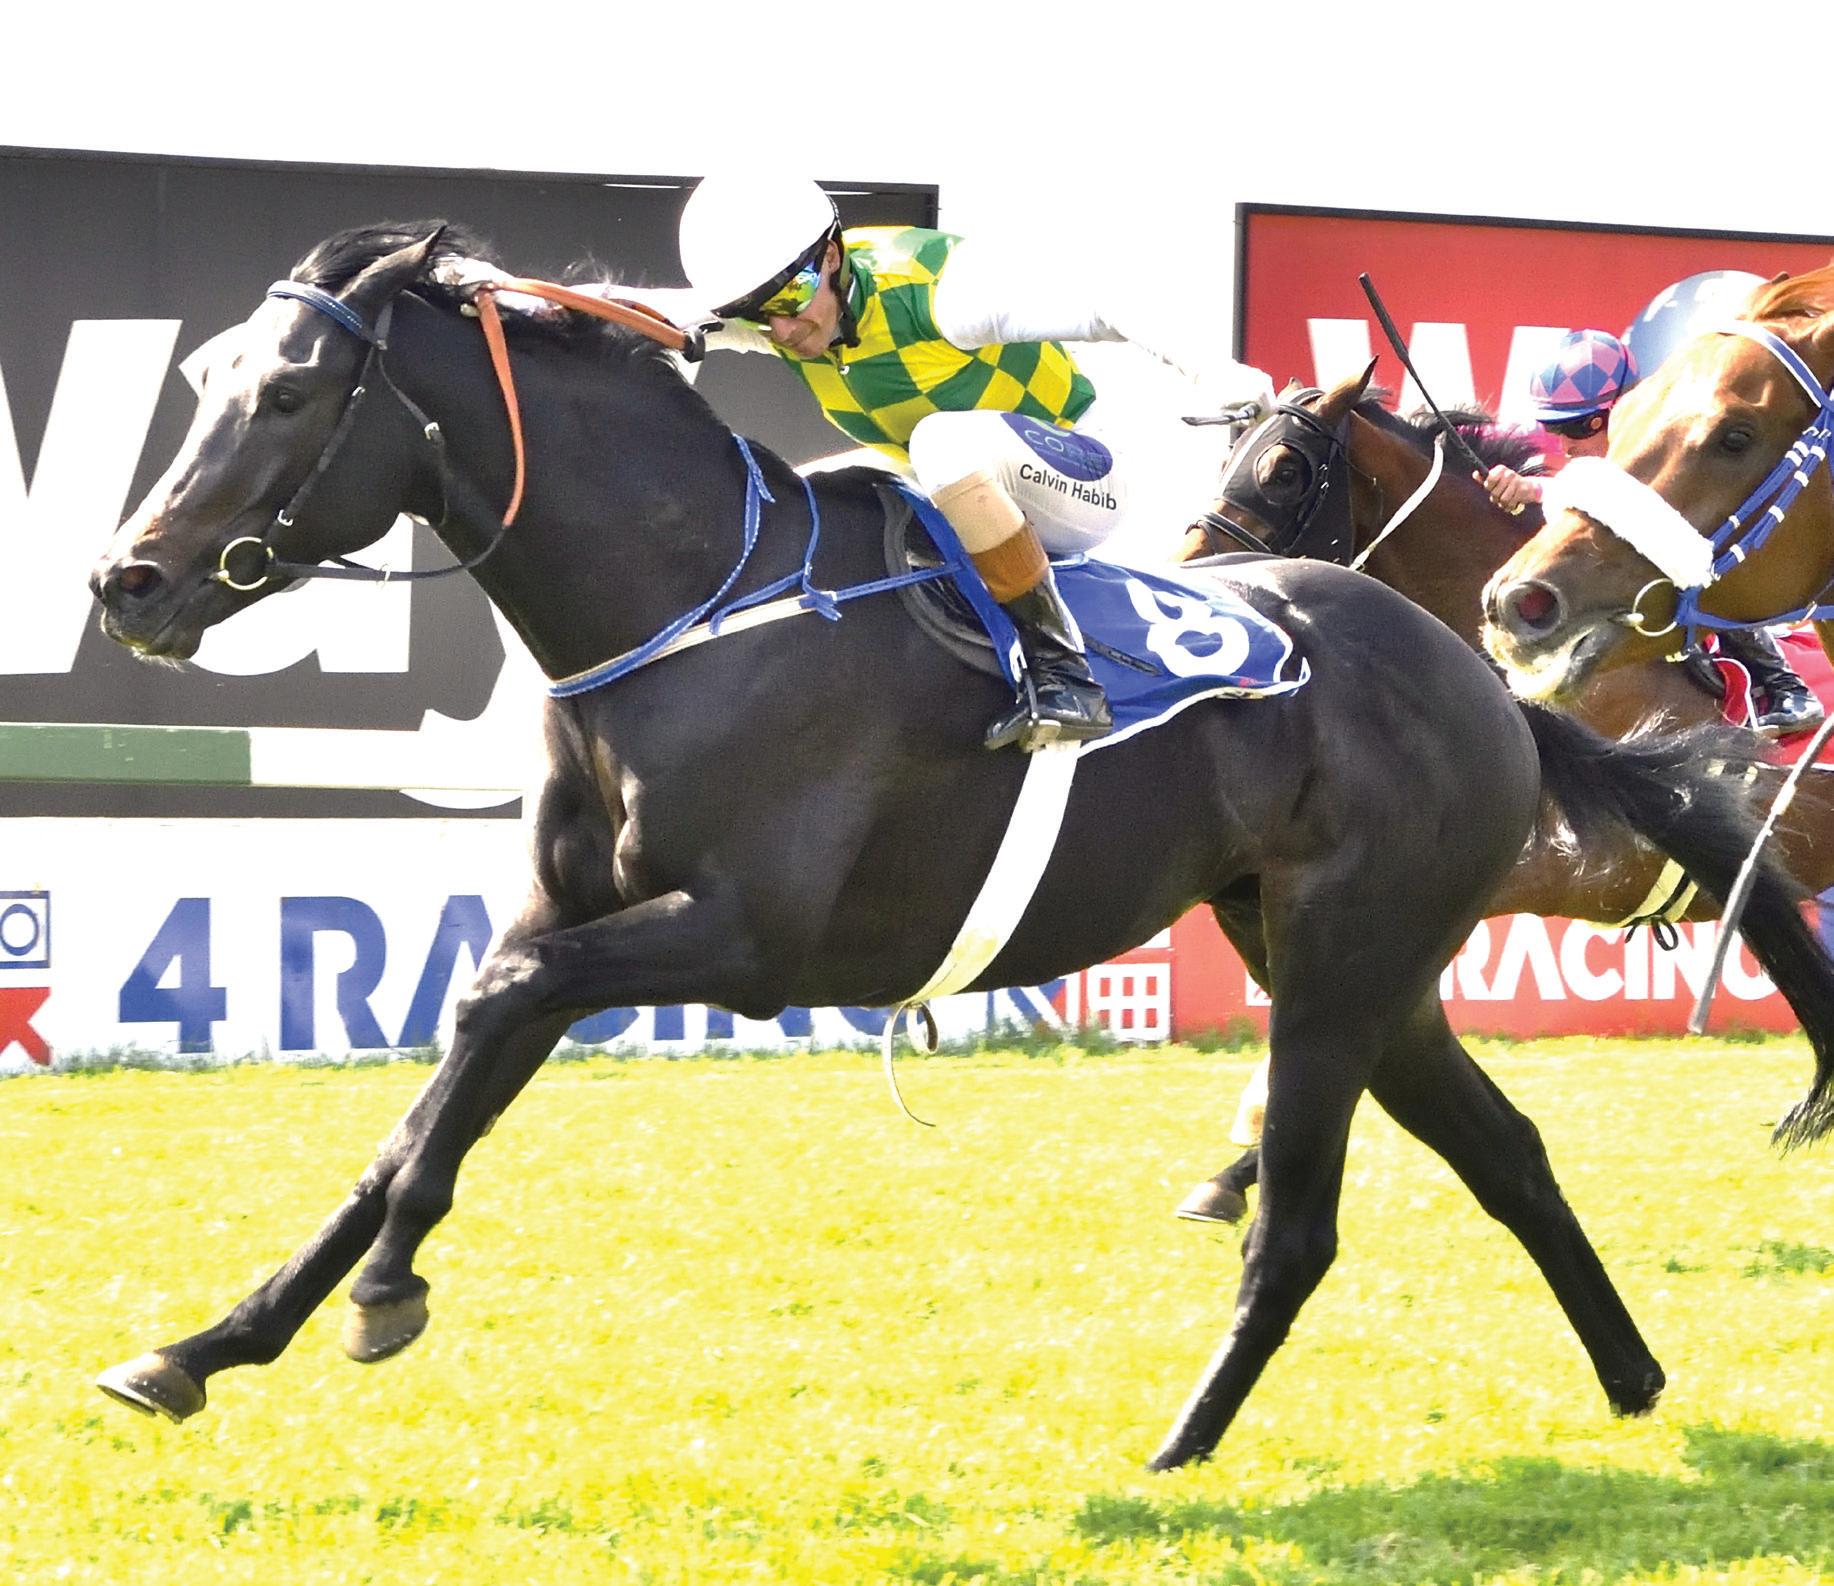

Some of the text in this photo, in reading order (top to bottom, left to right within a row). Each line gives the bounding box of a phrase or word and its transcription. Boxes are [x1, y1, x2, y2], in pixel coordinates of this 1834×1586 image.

[1019, 464, 1118, 511] Calvin Habib
[1125, 578, 1250, 678] 8
[119, 897, 227, 1053] 4
